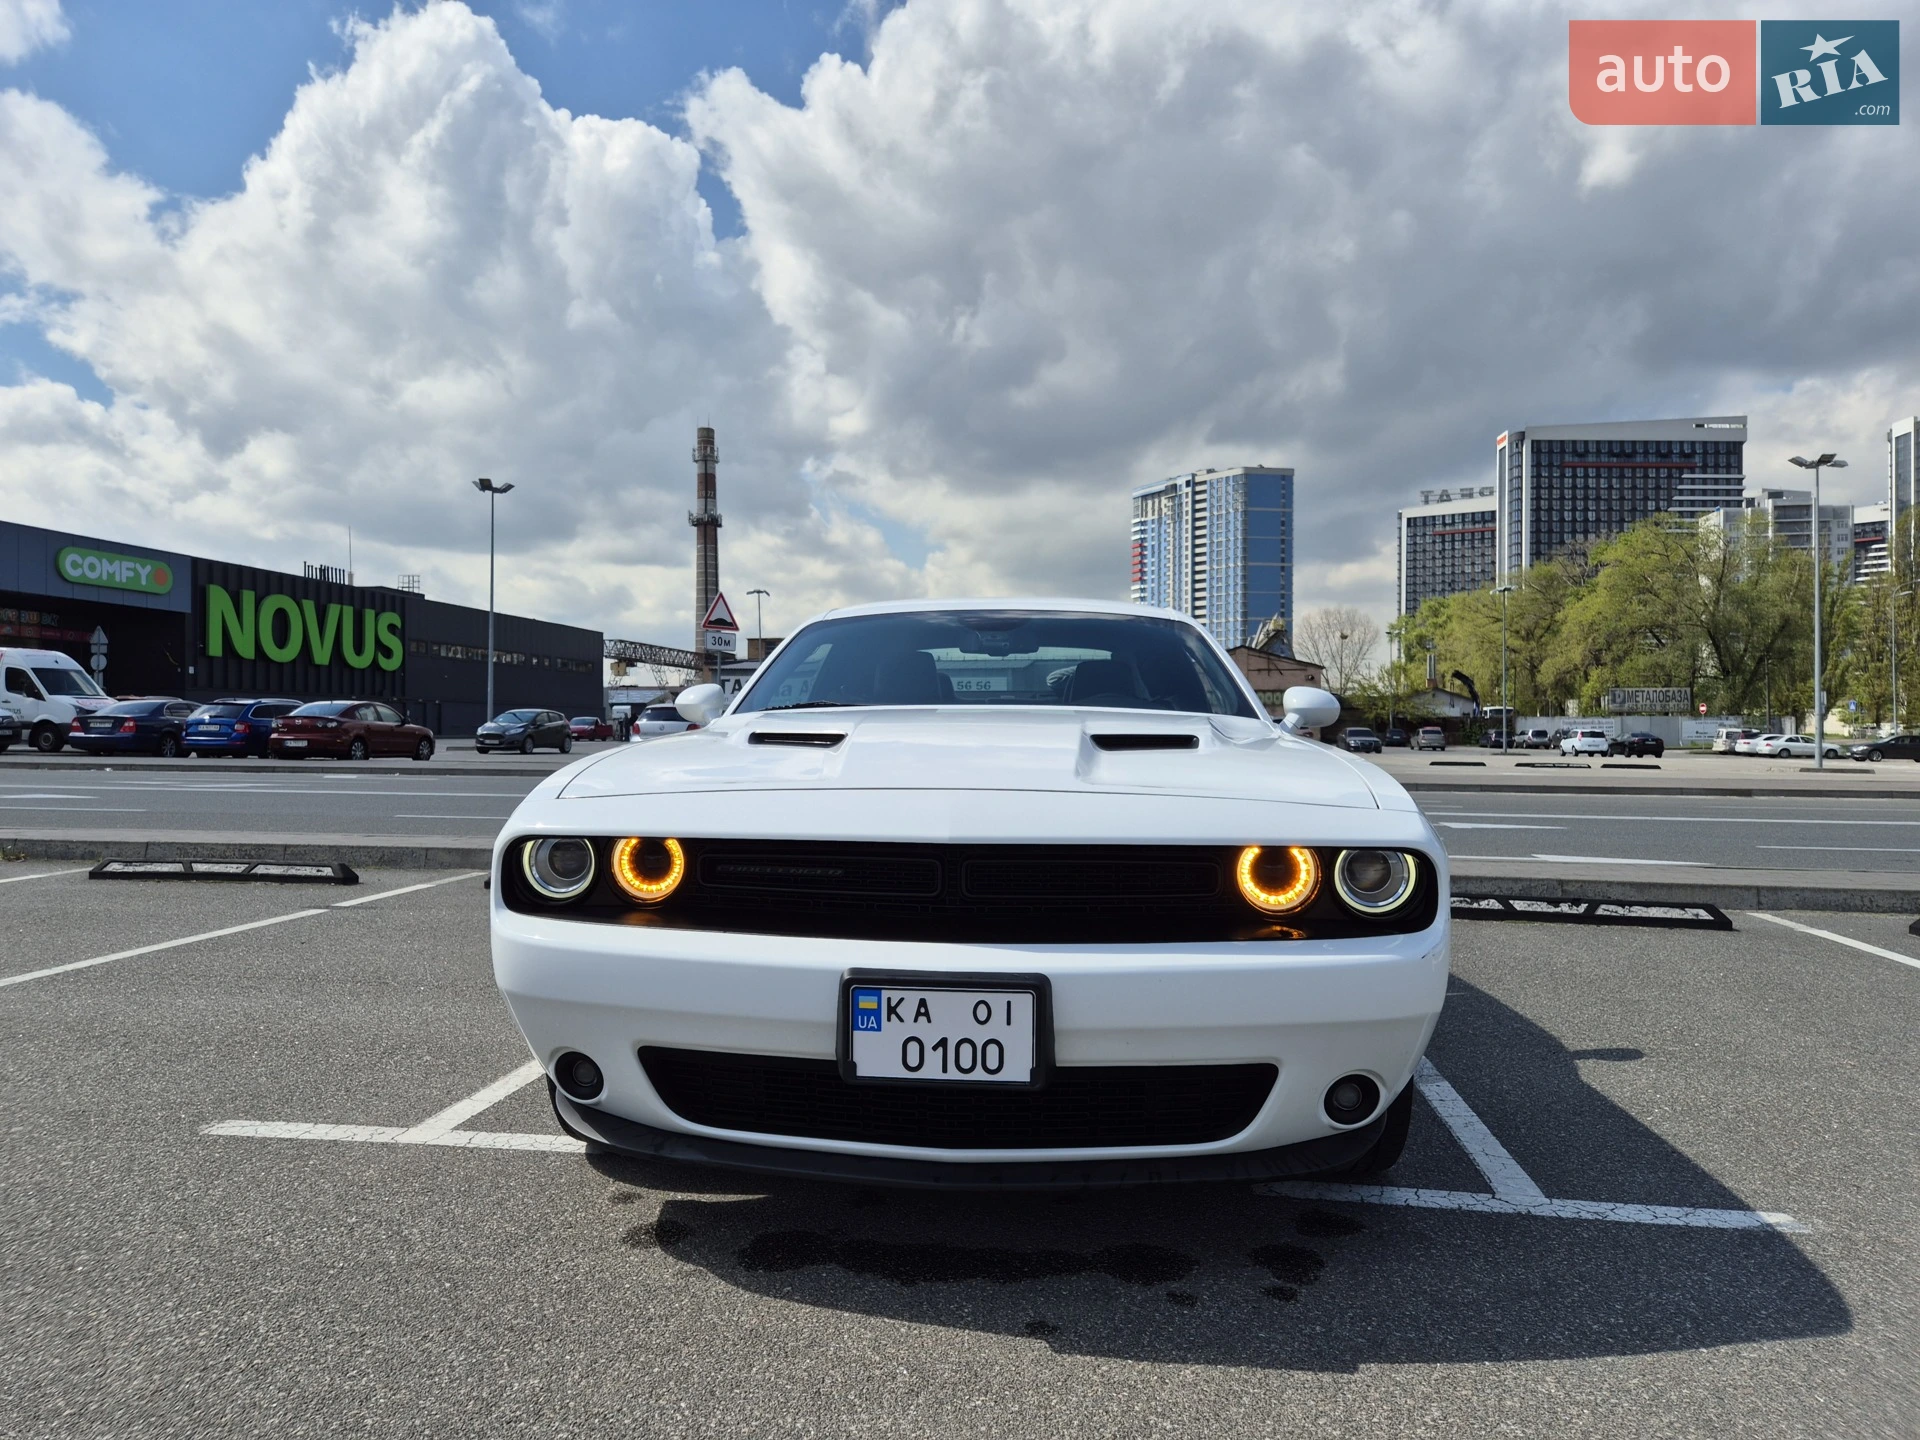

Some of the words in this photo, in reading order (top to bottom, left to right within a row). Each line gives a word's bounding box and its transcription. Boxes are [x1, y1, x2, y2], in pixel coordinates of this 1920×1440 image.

[65, 553, 152, 585] COMFY
[206, 583, 404, 672] NOVUS
[957, 681, 972, 690] 56
[976, 681, 991, 690] 56
[1626, 689, 1690, 703] МЕТАЛОБАЗА
[858, 1015, 878, 1029] UA
[886, 996, 932, 1023] KA
[901, 1035, 1005, 1075] 0100
